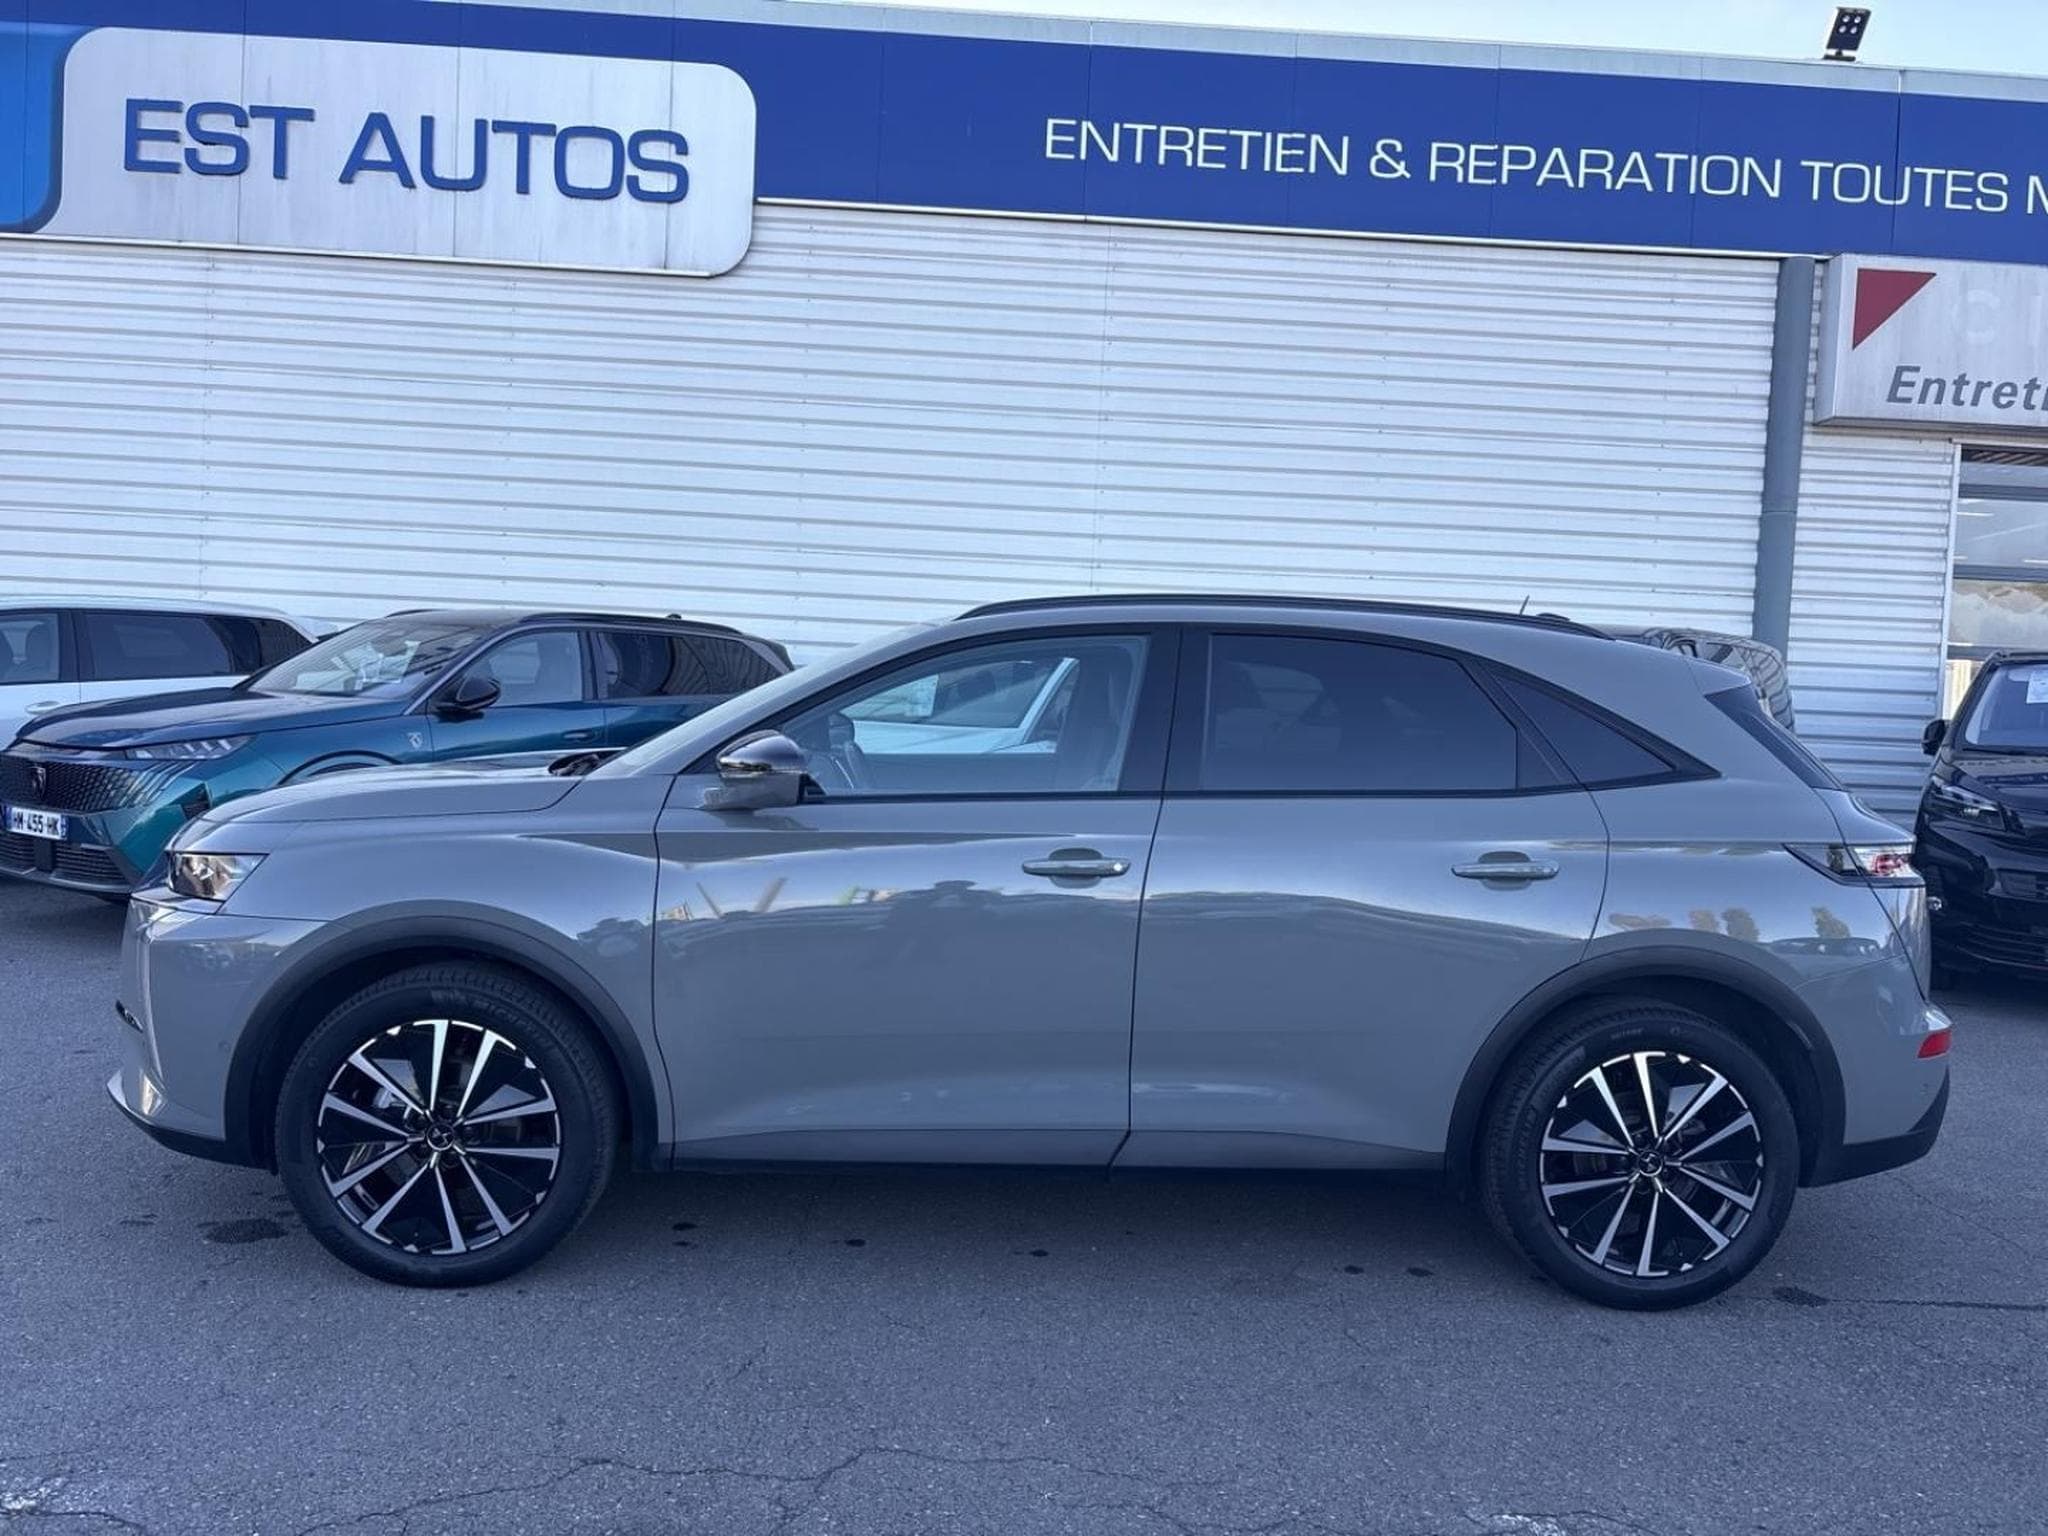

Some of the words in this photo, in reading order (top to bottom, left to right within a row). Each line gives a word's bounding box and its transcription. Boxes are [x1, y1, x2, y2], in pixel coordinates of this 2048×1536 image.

[124, 98, 314, 180] EST
[339, 112, 690, 204] AUTOS
[1045, 118, 1349, 176] ENTRETIEN
[1370, 138, 1411, 179] &
[1429, 142, 1782, 198] REPARATION
[1800, 160, 2009, 213] TOUTES
